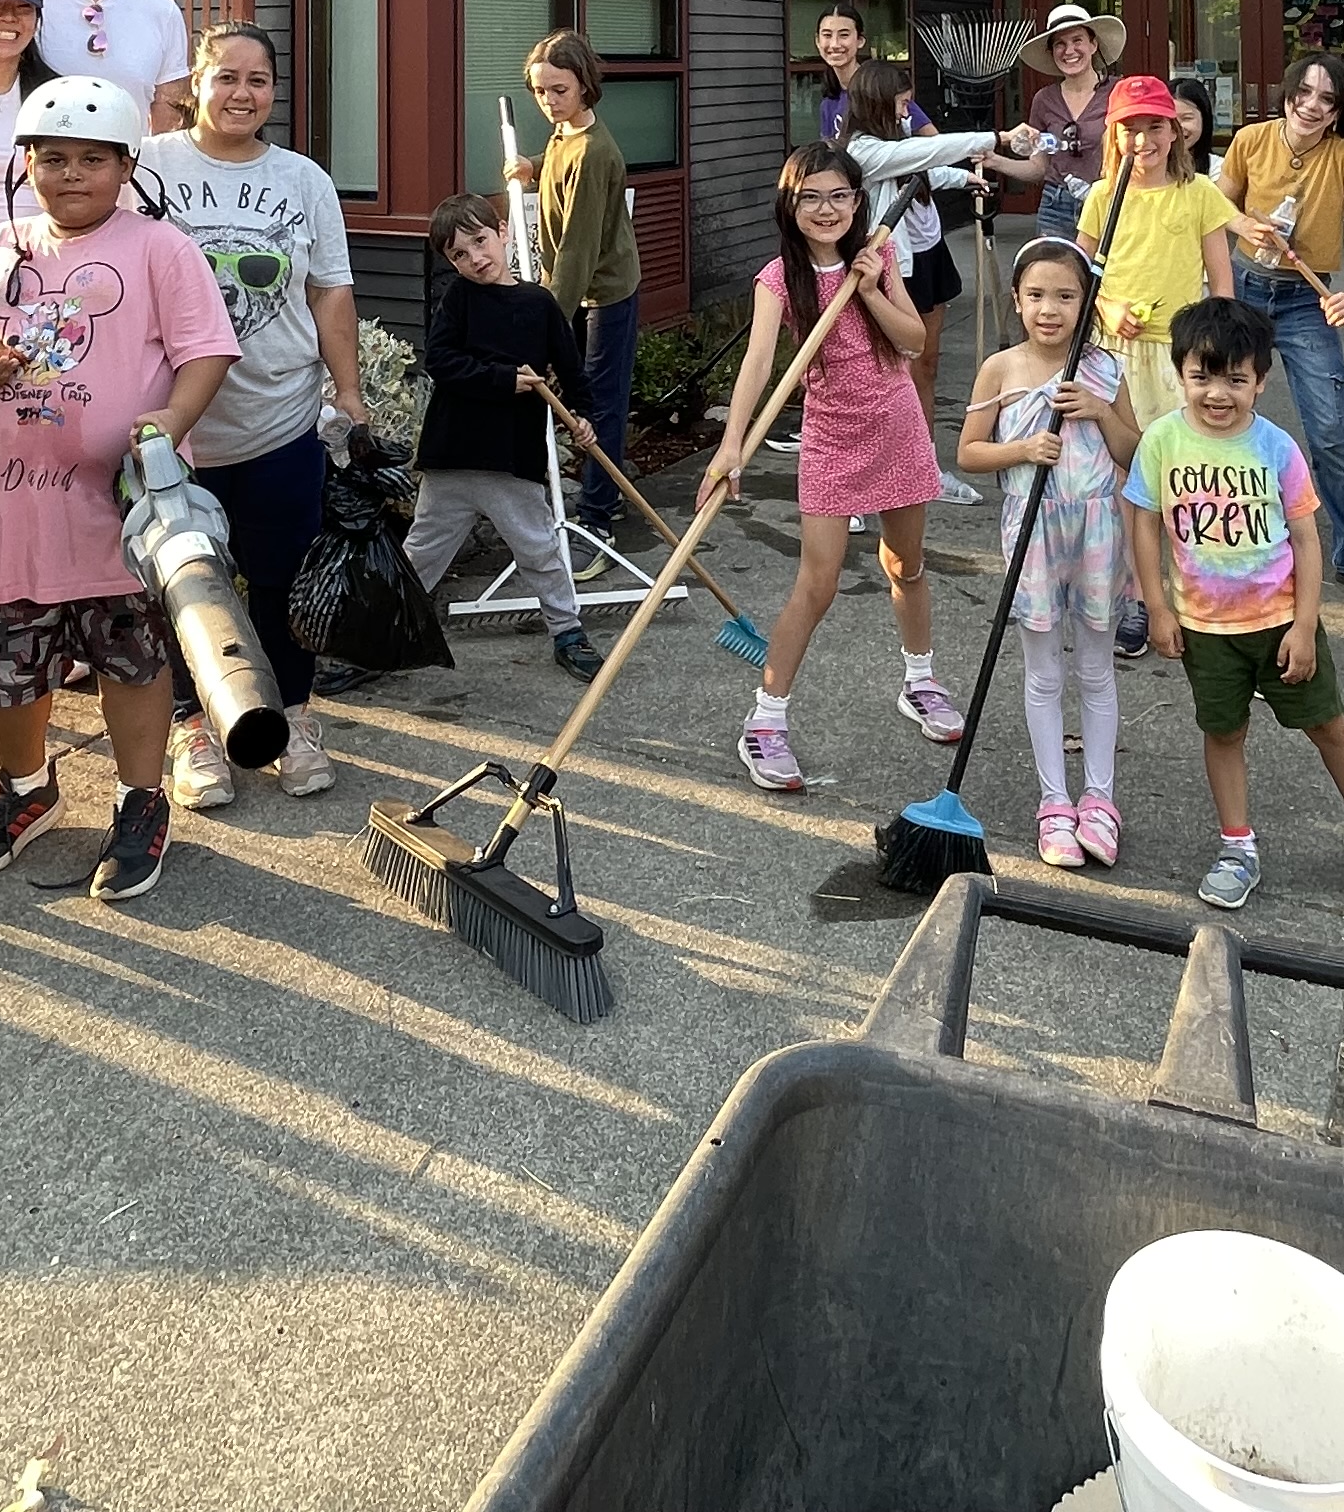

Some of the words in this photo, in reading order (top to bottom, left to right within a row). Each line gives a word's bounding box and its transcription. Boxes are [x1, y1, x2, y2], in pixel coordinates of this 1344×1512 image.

[158, 180, 218, 214] APA
[237, 182, 305, 235] BEAR
[0, 382, 52, 407] Disney
[57, 380, 92, 407] Trip
[0, 457, 79, 492] David
[1169, 462, 1269, 498] COUSIN
[1172, 501, 1272, 547] CREW
